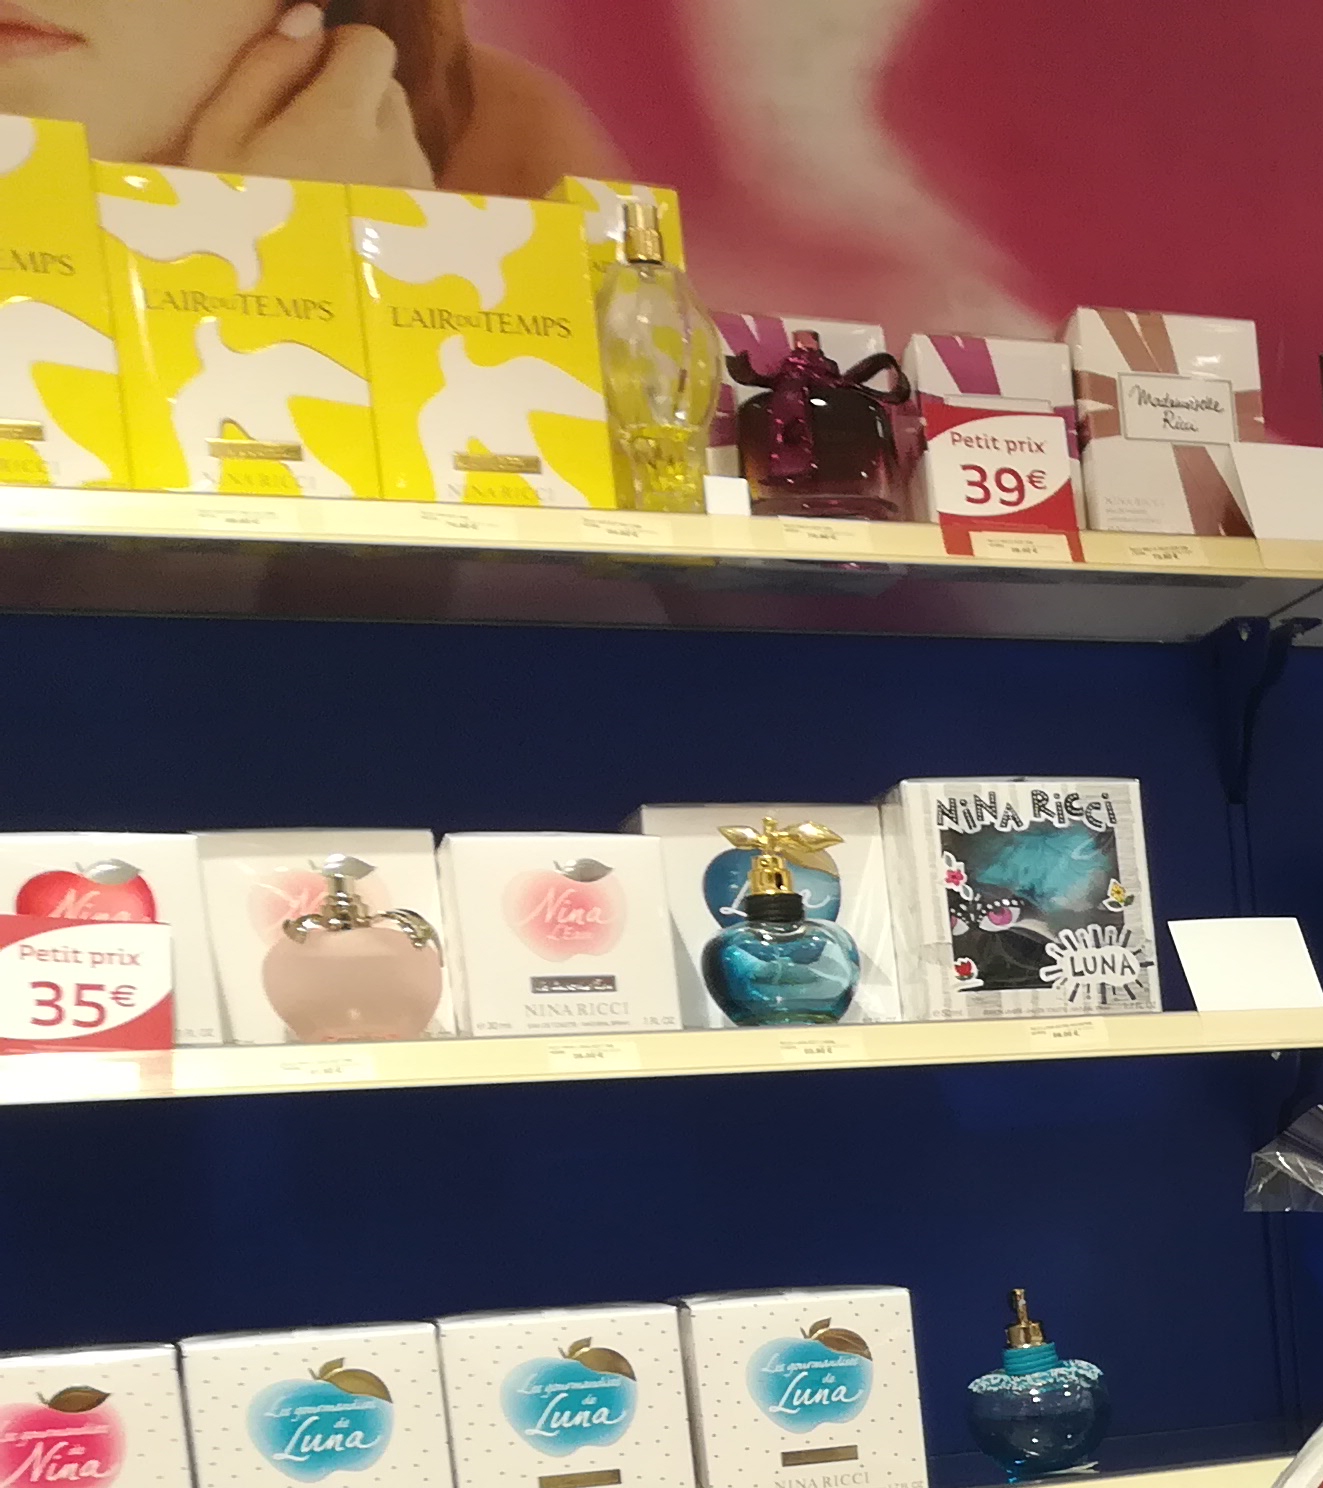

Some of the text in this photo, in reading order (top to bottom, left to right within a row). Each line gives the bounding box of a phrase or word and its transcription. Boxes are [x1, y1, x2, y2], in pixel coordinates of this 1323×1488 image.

[481, 310, 572, 340] TEMPS
[951, 431, 1046, 455] Petit prix
[961, 463, 1048, 507] 39€
[937, 789, 1117, 830] NINA RICCI
[519, 888, 610, 926] Nina
[19, 945, 141, 968] Petit prix
[1068, 951, 1138, 978] LUNA
[30, 981, 137, 1028] 35€
[524, 1001, 630, 1018] NINA RICCI
[769, 1371, 864, 1413] Luna
[526, 1393, 628, 1436] Luna
[272, 1416, 382, 1461] Luna
[825, 1471, 870, 1488] RICCI
